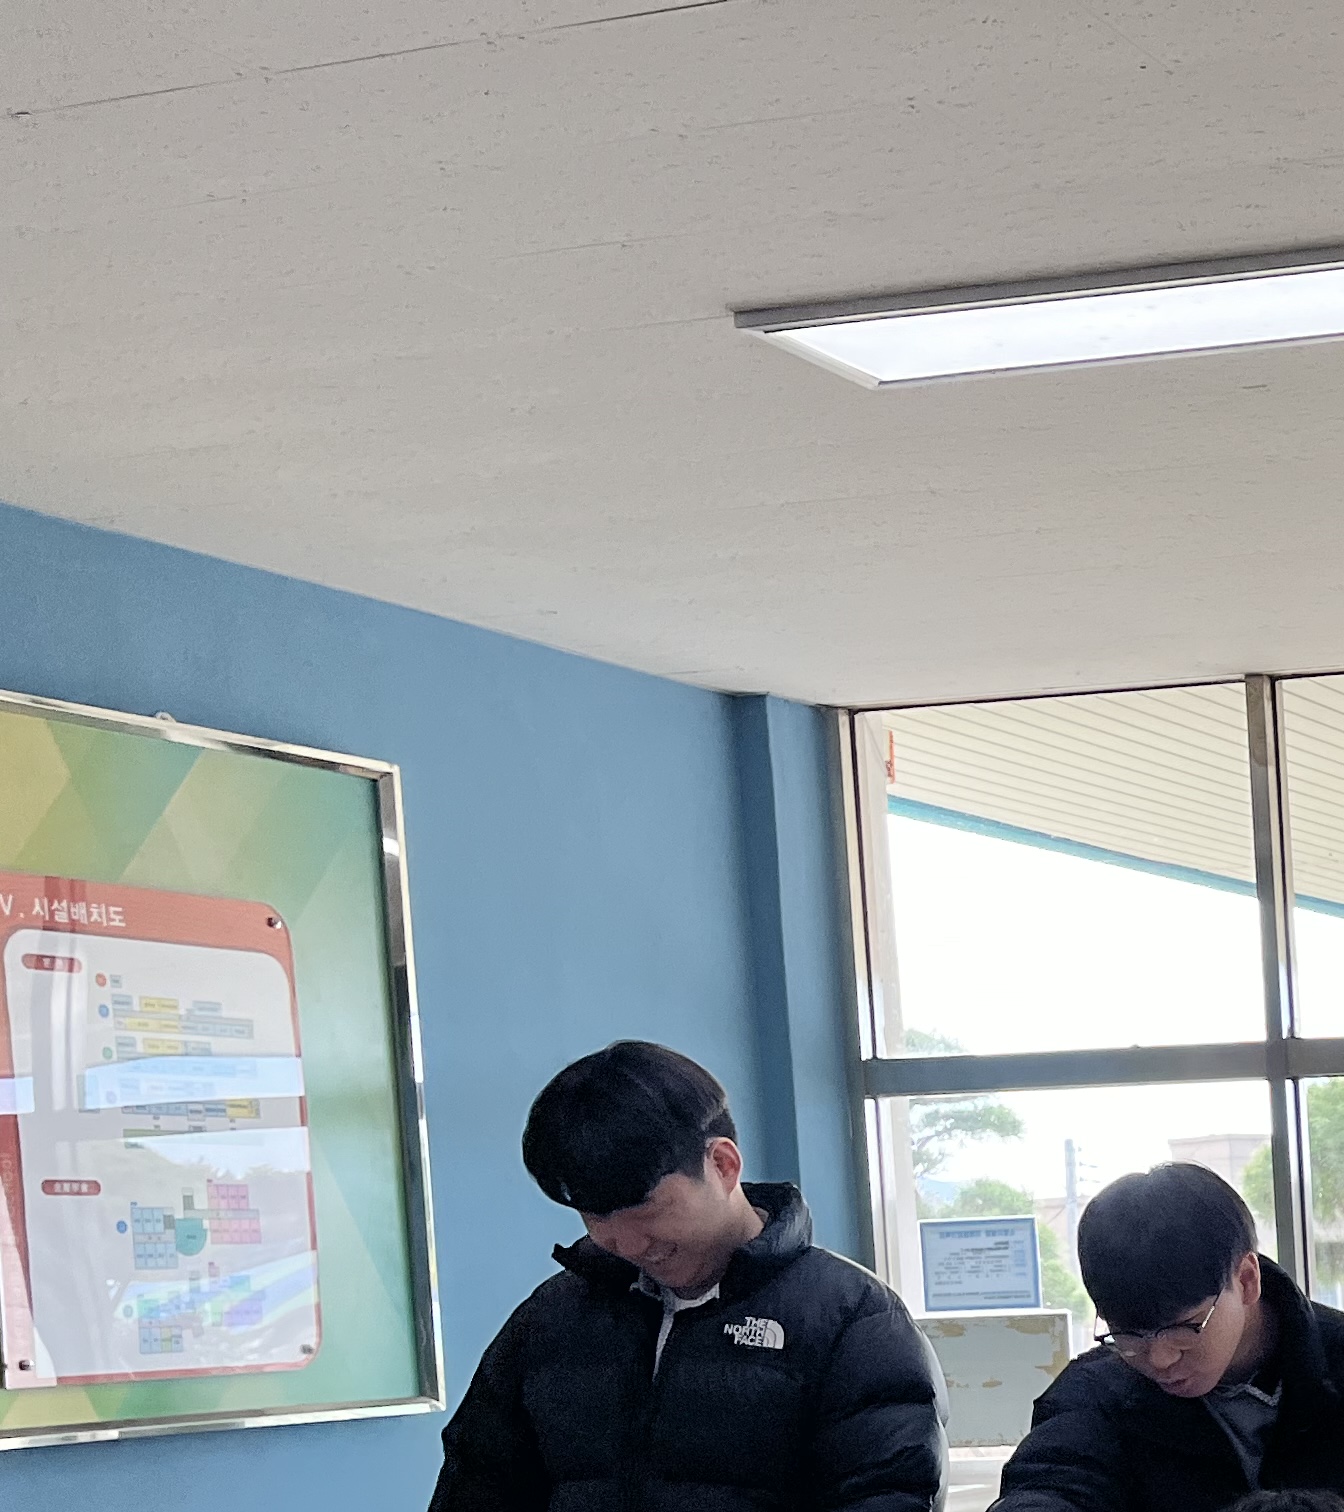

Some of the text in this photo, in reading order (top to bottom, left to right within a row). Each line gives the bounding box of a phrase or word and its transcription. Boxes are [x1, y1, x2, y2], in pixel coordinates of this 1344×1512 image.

[32, 897, 126, 927] 시설배치도
[745, 1316, 768, 1329] THE
[723, 1323, 764, 1337] NORTH
[733, 1333, 764, 1347] FACE
